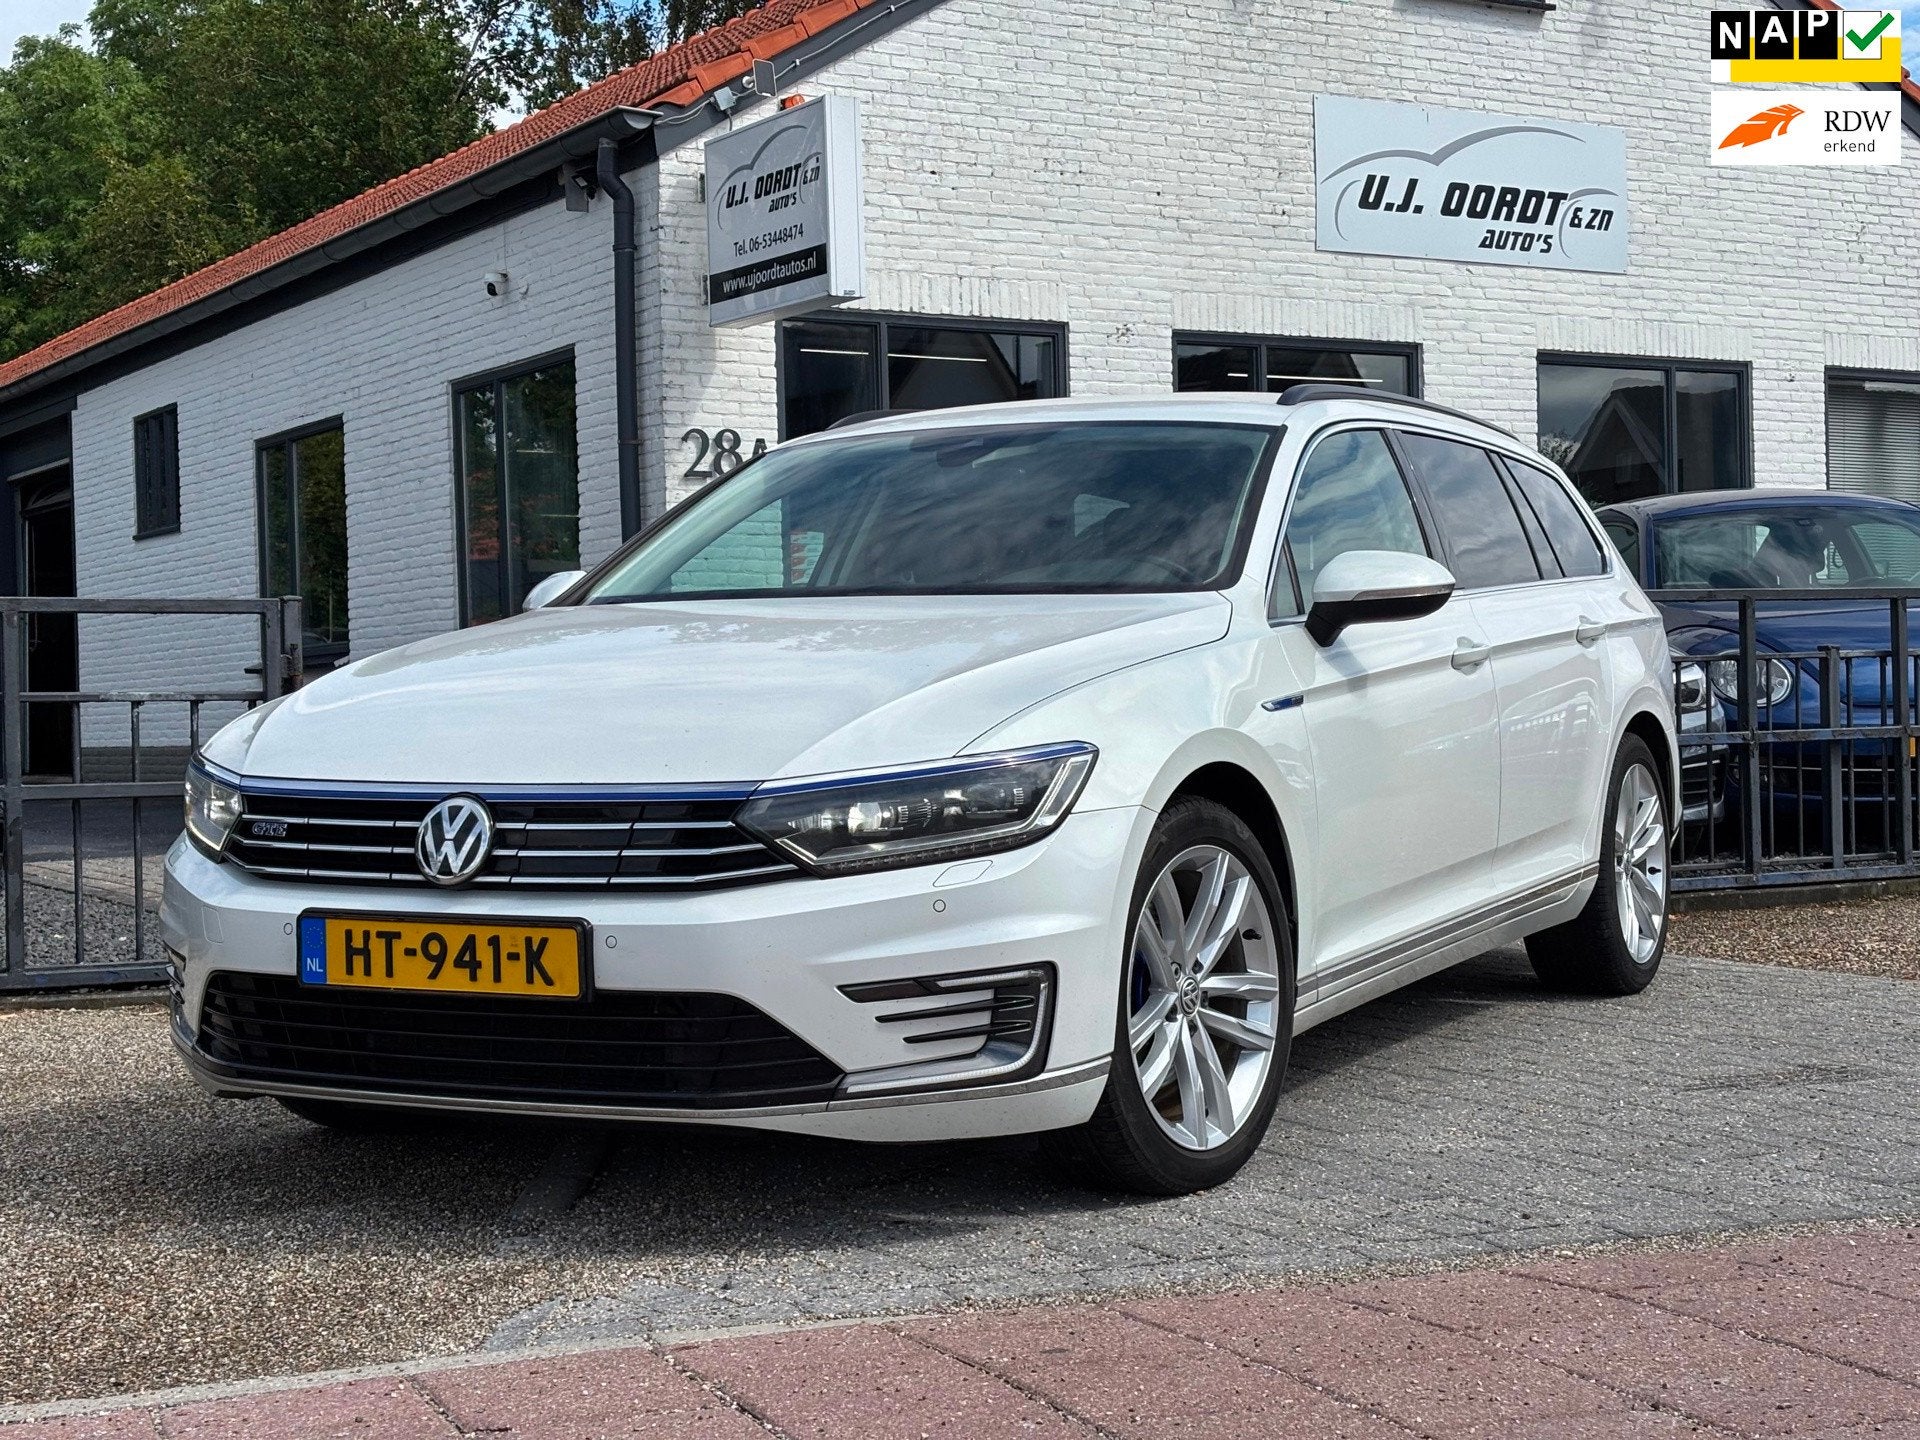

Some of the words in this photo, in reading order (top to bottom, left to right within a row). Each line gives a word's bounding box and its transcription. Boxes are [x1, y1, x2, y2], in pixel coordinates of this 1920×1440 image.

[726, 182, 748, 209] U.J.
[754, 163, 801, 200] OORDT
[1358, 174, 1424, 214] U.J.
[1440, 182, 1569, 226] OORDT
[1569, 207, 1583, 228] &
[734, 241, 748, 257] Tel.
[749, 223, 804, 252] 06-53448474
[722, 251, 817, 293] www.ujoordtautos.nl
[252, 821, 287, 836] GTE
[306, 957, 324, 973] NL
[344, 928, 555, 987] HT-941-K
